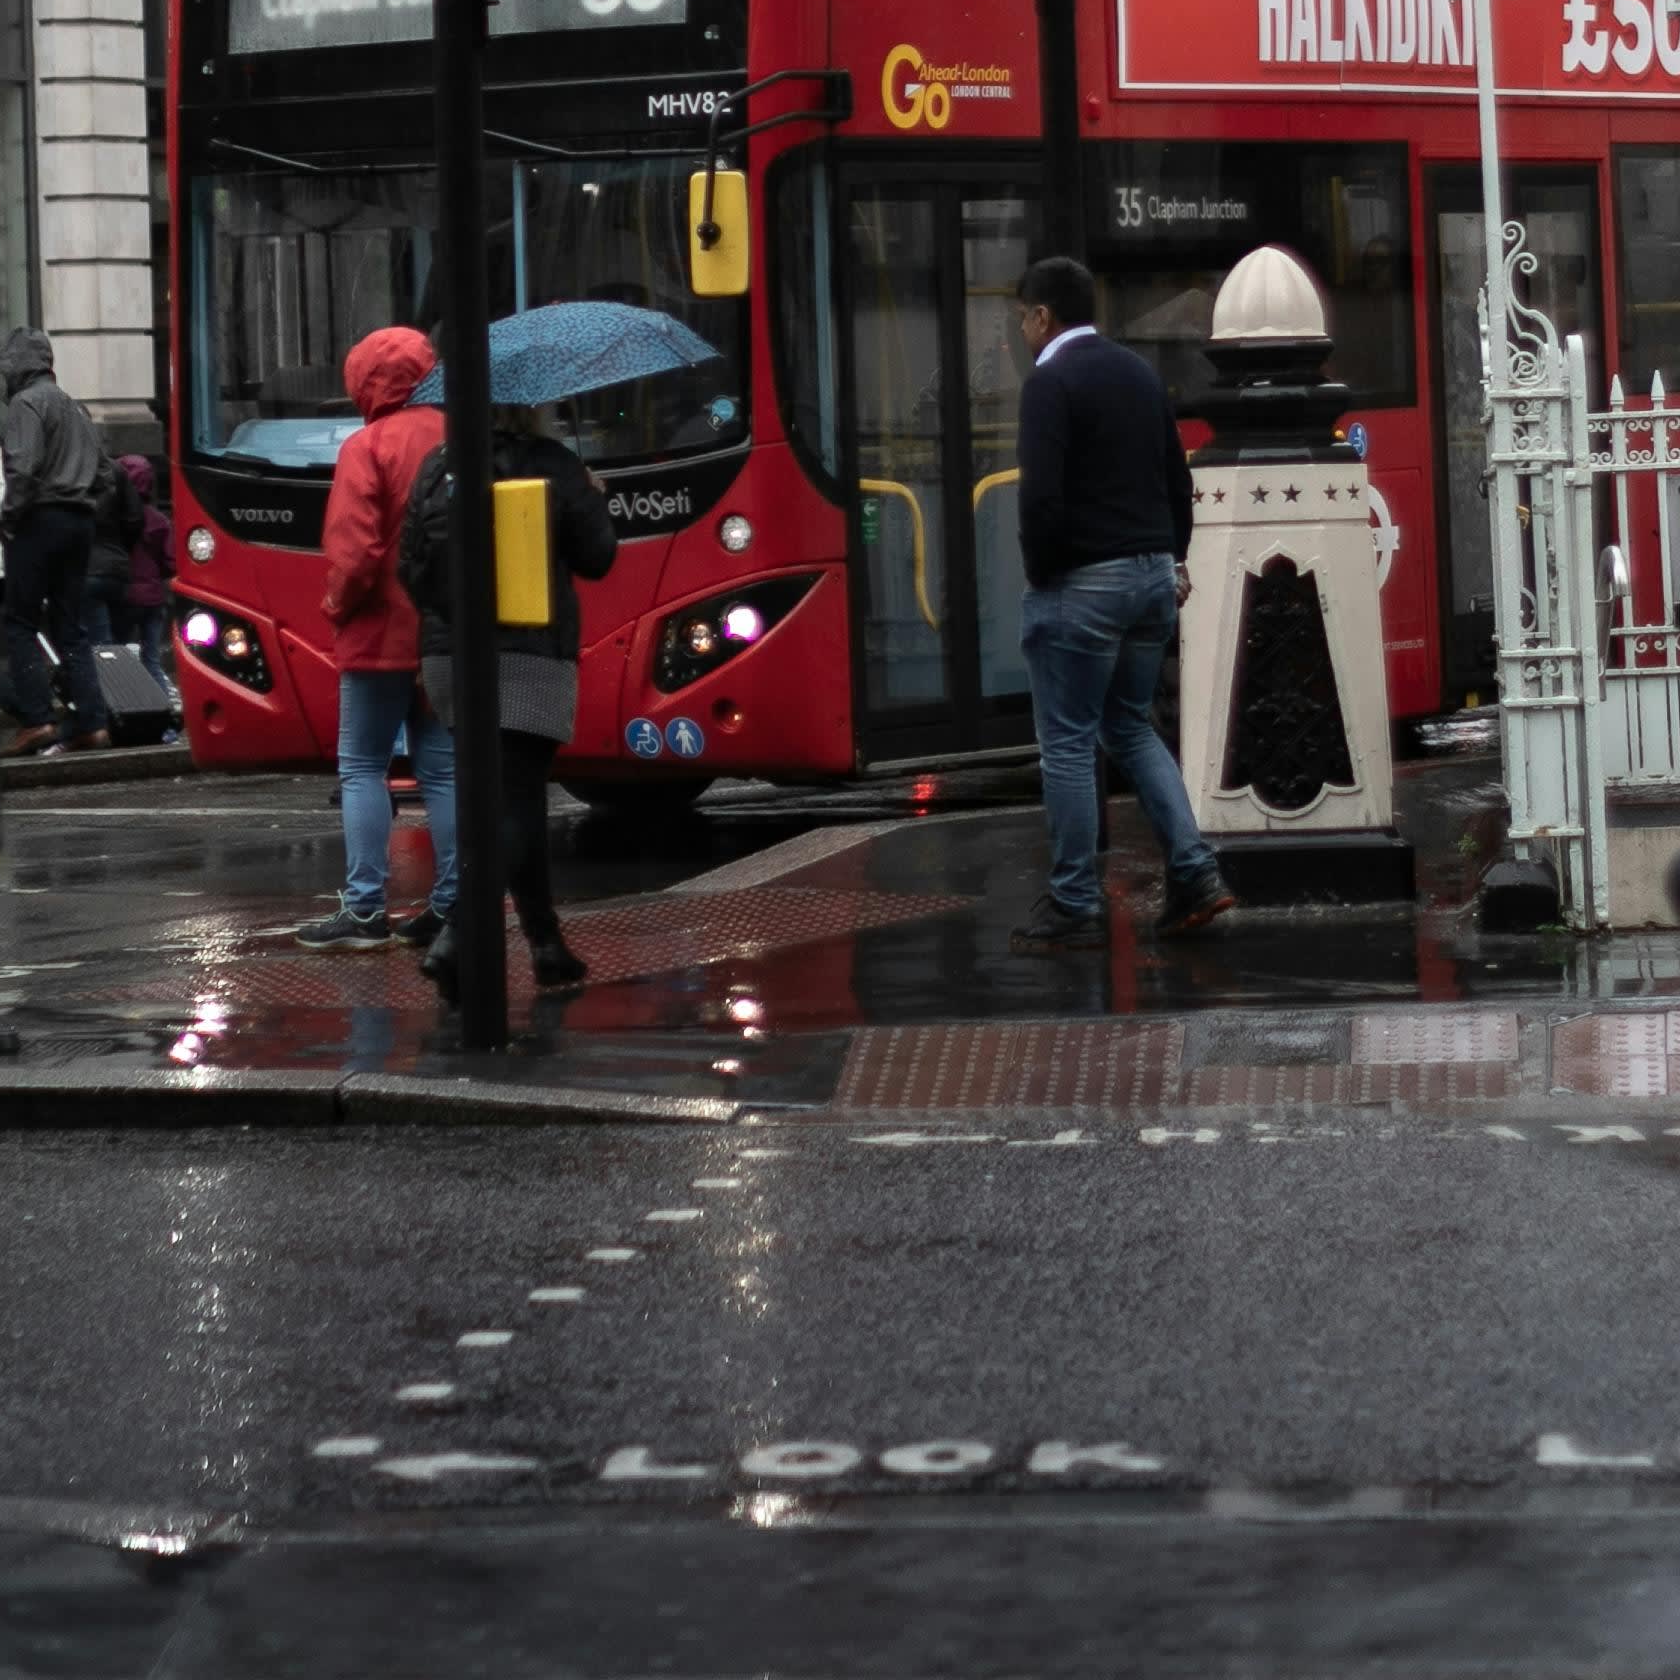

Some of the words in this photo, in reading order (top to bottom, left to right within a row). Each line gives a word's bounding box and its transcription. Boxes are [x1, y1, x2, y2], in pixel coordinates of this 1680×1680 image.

[881, 43, 951, 129] Go
[919, 62, 1010, 82] Ahead-London
[951, 85, 981, 98] LONDON
[981, 85, 1012, 99] CENTRAL
[1115, 187, 1143, 227] 35
[1147, 196, 1198, 225] Clapham
[1200, 196, 1246, 220] Junction
[229, 508, 294, 524] VOLVO
[608, 487, 690, 521] eVoSeti
